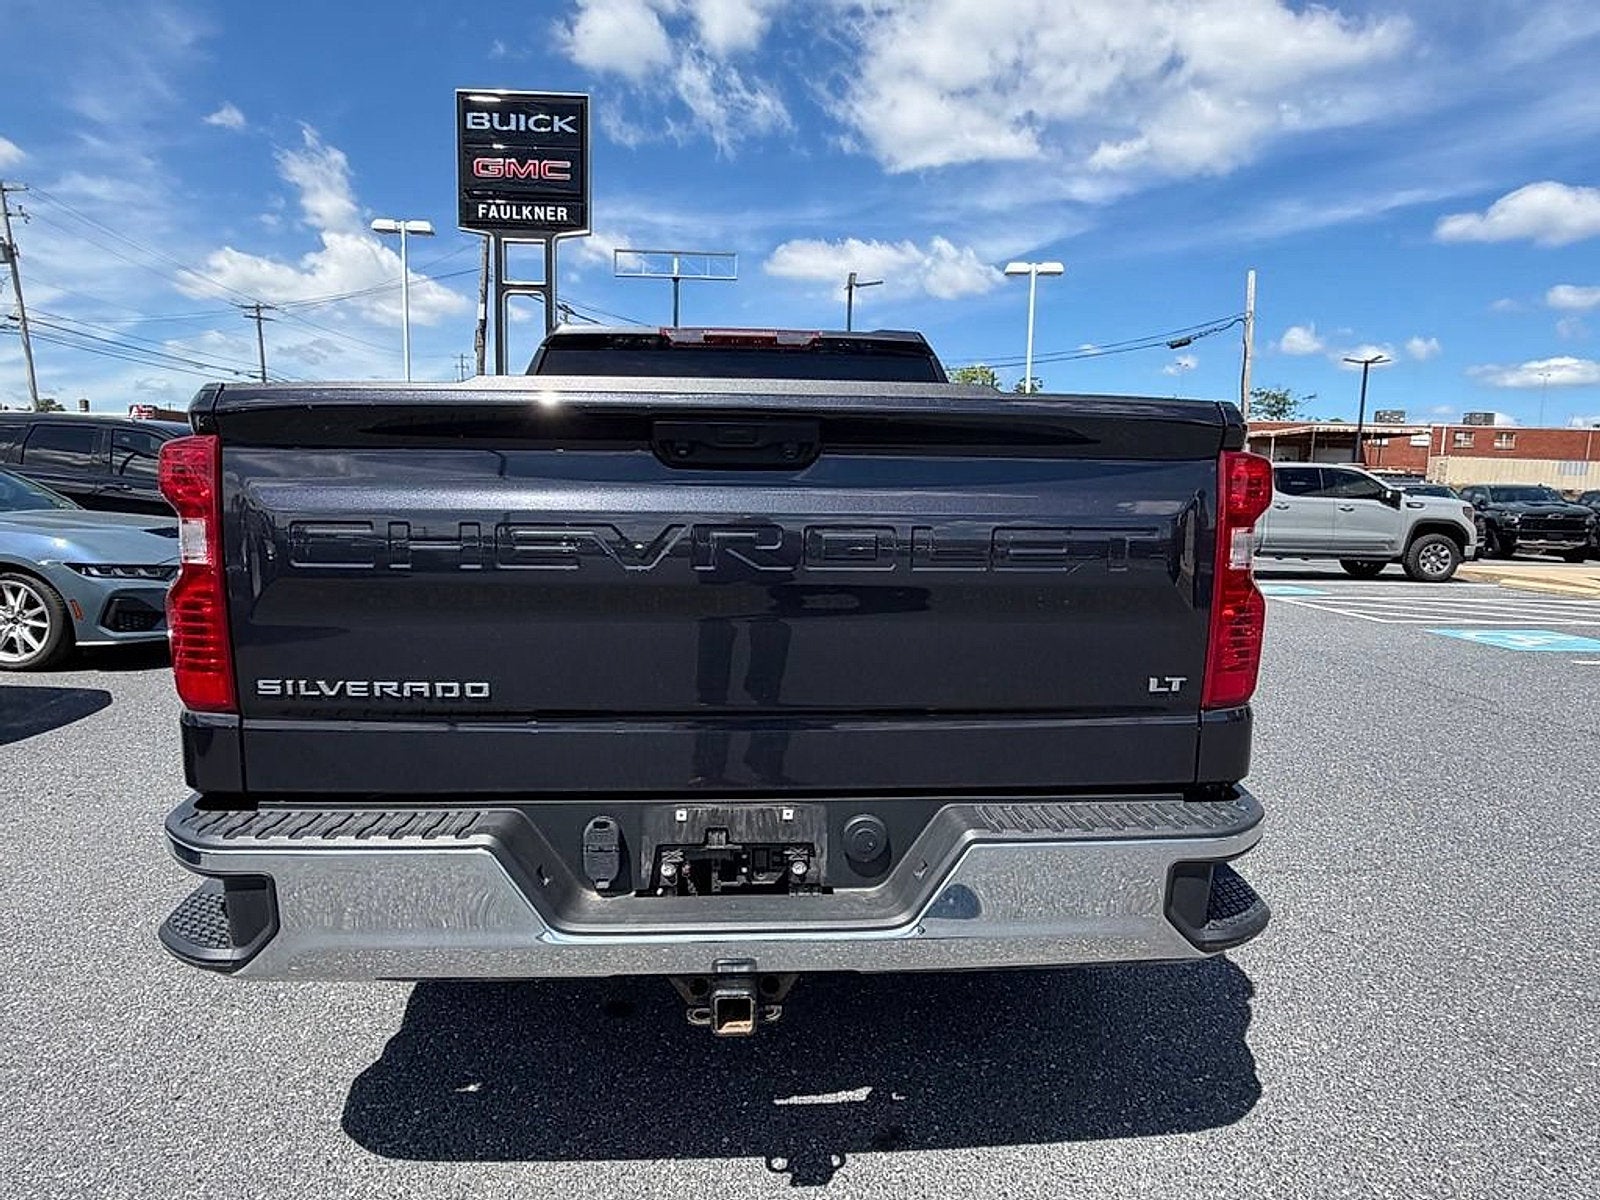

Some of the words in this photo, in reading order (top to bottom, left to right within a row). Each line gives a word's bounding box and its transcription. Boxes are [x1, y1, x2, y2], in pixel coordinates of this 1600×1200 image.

[467, 112, 576, 133] BUICK
[473, 157, 571, 180] GMC
[478, 204, 568, 221] FAULKNER
[287, 519, 1162, 572] CHEVROLET
[256, 679, 490, 698] SILVERADO
[1149, 676, 1187, 692] LT
